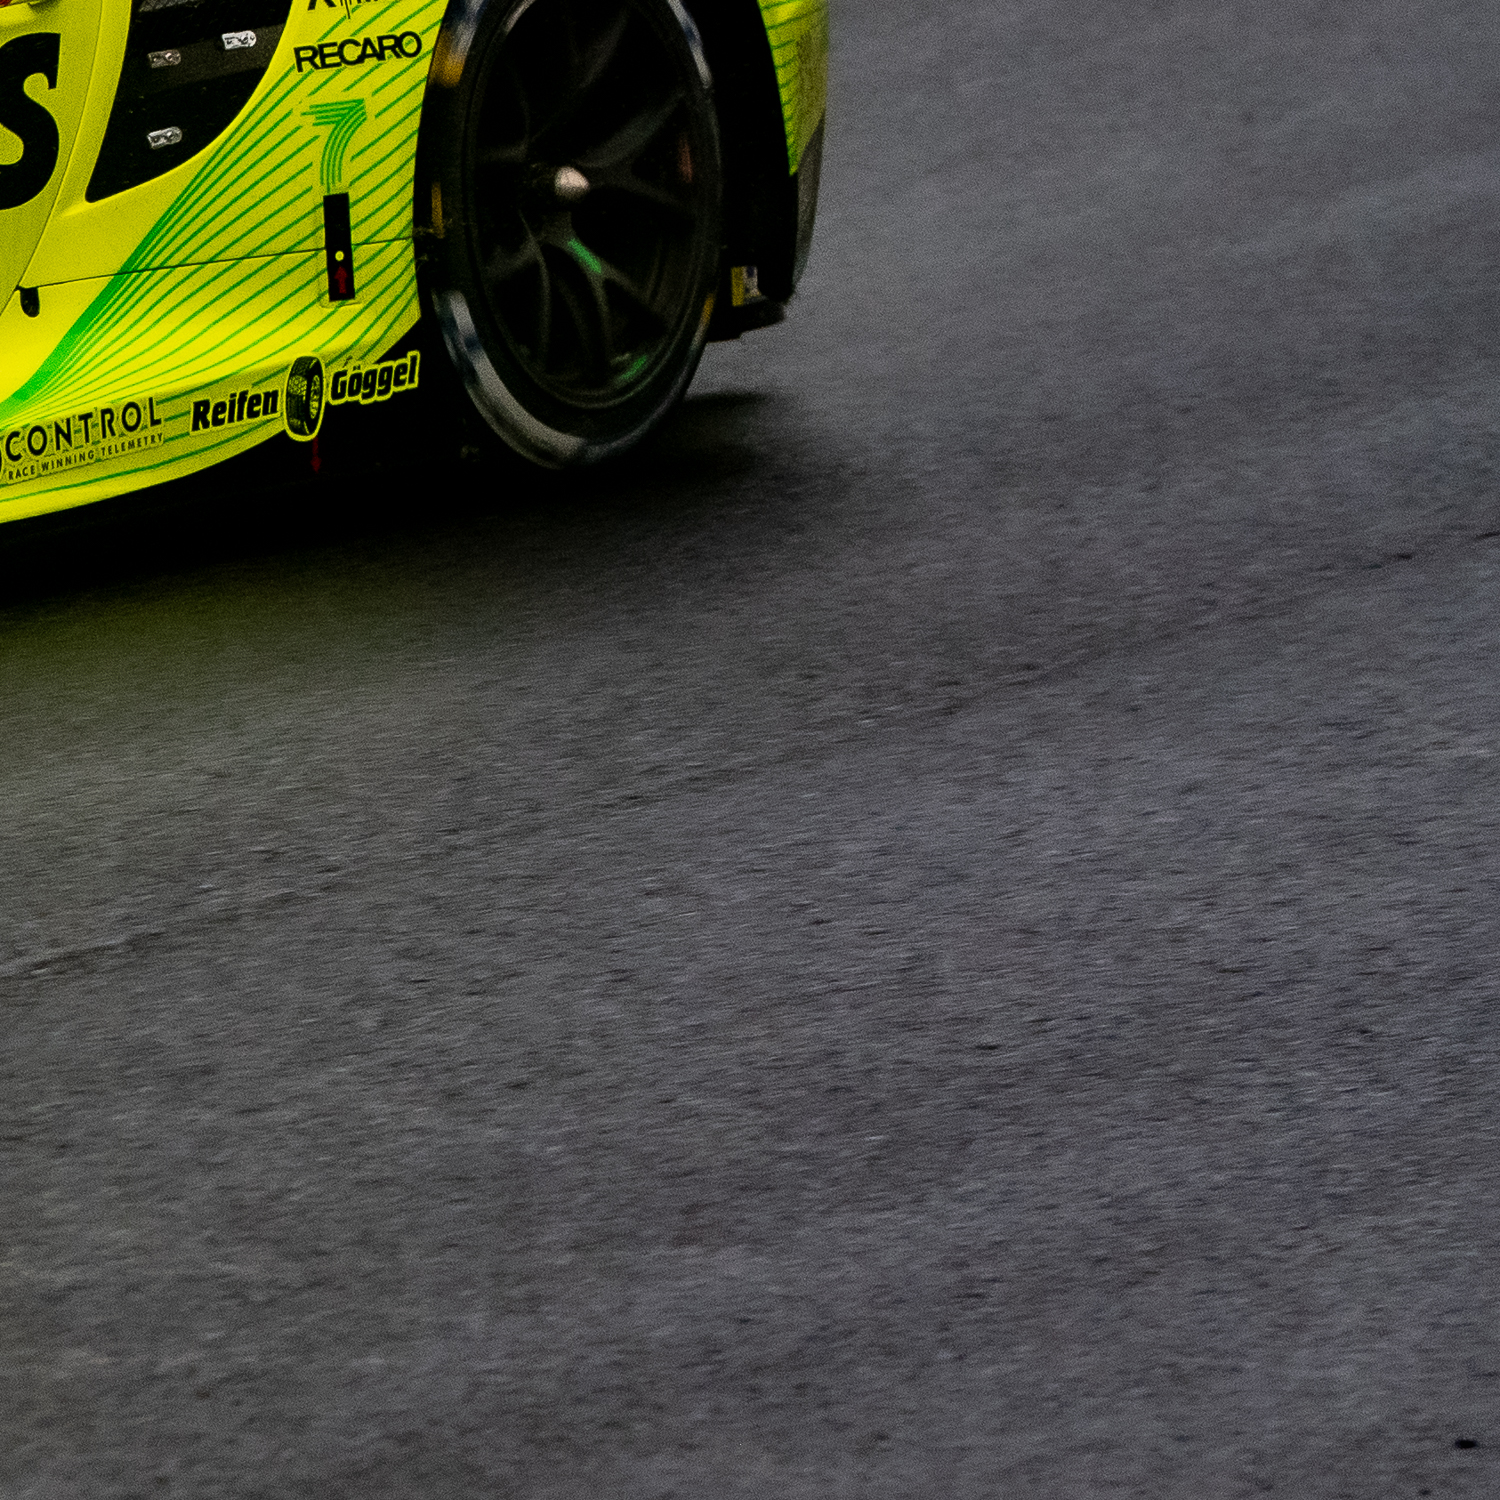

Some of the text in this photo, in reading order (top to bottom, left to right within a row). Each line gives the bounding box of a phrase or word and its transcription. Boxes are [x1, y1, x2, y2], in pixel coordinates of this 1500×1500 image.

[293, 30, 423, 73] RECARO
[192, 354, 419, 432] Reifen Göggel
[5, 396, 162, 463] CONTROL
[8, 432, 164, 481] RACE WINNING TELEMETRY
